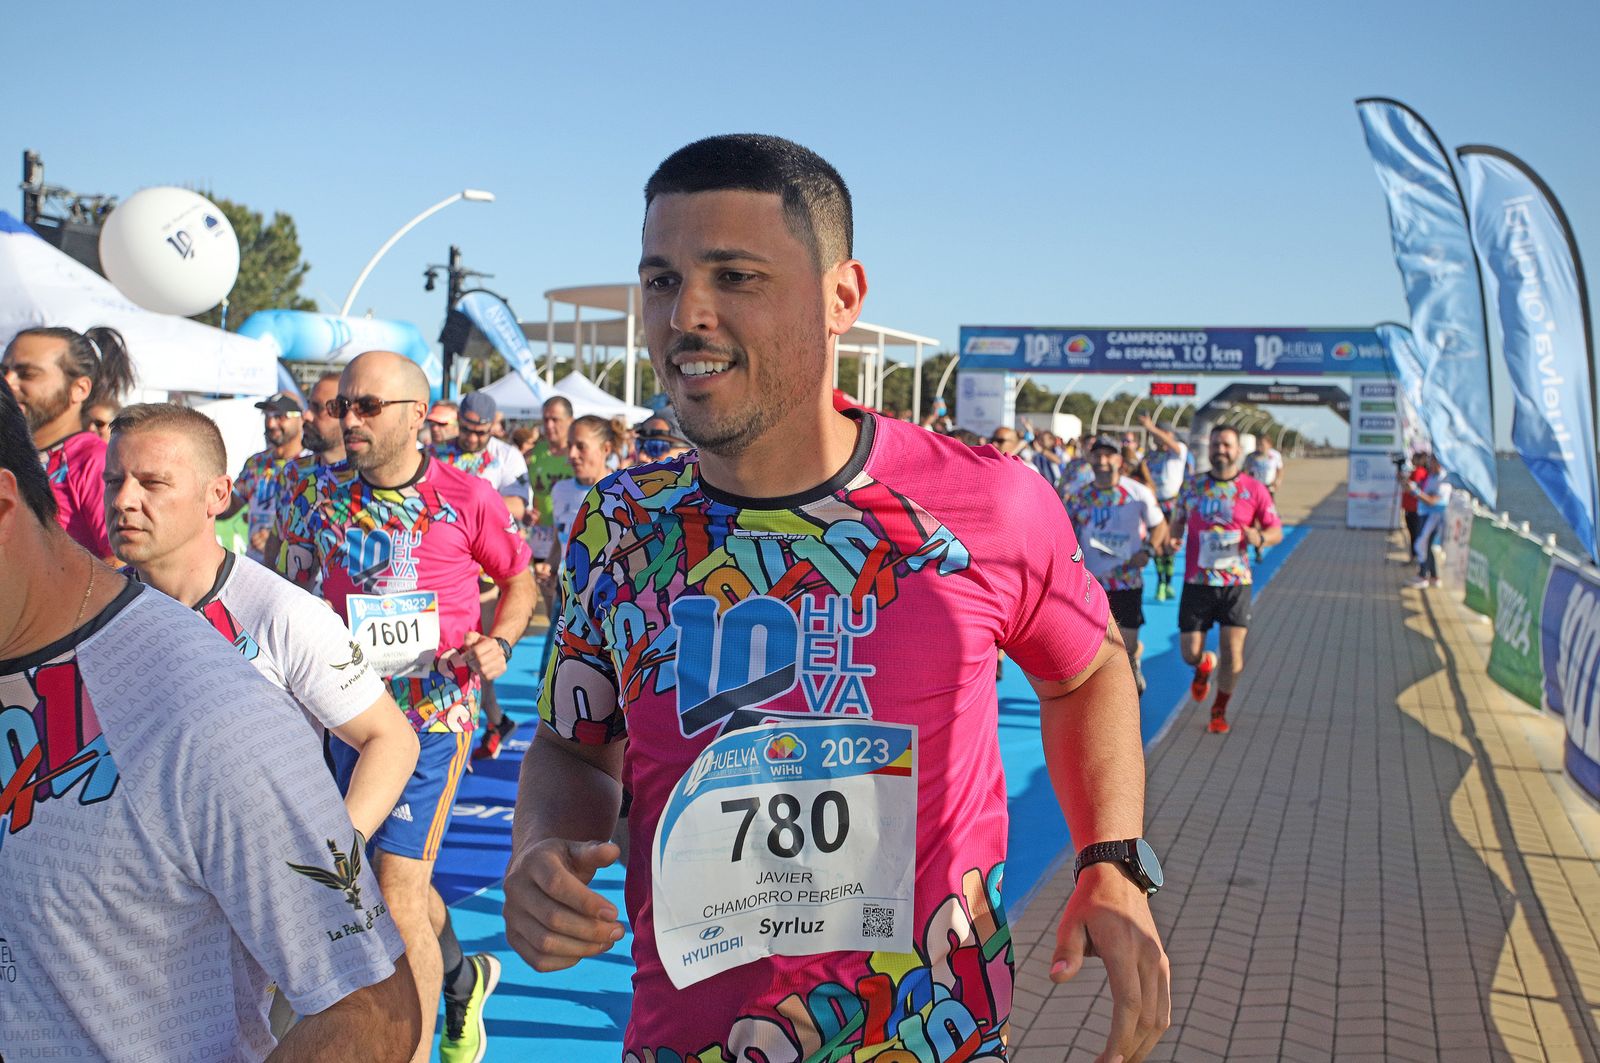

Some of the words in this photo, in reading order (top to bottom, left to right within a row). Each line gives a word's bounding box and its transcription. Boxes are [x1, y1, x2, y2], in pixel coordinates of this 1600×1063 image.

[1107, 332, 1207, 345] CAMPEONATO
[1106, 347, 1122, 360] de
[1124, 346, 1175, 360] ESPAÑA
[1183, 346, 1205, 360] 10
[1211, 345, 1243, 362] km
[392, 530, 422, 547] HU
[346, 528, 391, 584] 10
[392, 547, 418, 563] EL
[392, 562, 418, 578] VA
[400, 597, 427, 612] 2023
[803, 594, 876, 634] HU
[90, 609, 145, 652] LUCENA
[103, 614, 162, 661] PATERNA
[367, 618, 419, 647] 1601
[98, 627, 170, 686] CONDADO
[669, 595, 799, 738] 10
[802, 633, 876, 675] EL
[114, 675, 138, 698] DE
[137, 673, 169, 698] DEL
[800, 674, 873, 715] VA
[189, 700, 215, 723] DE
[202, 709, 240, 741] CALA
[125, 716, 167, 762] ZUFRE
[821, 737, 890, 768] 2023
[708, 745, 760, 773] HUELVA
[770, 764, 803, 777] WiHu
[720, 790, 850, 862] 780
[14, 848, 105, 876] VILLANUEVA
[756, 872, 813, 885] JAVIER
[15, 890, 97, 911] BERROCAL
[702, 890, 795, 920] CHAMORRO
[797, 882, 865, 903] PEREIRA
[117, 927, 140, 936] DE
[144, 907, 212, 935] ENMEDIO
[327, 929, 343, 942] La
[758, 917, 825, 936] Syrluz
[104, 944, 122, 957] EL
[125, 934, 178, 951] CERRO
[191, 952, 210, 967] LA
[682, 935, 744, 967] HYUNDAI
[107, 982, 169, 1014] MARINES
[173, 966, 231, 990] LUCENA
[28, 1009, 77, 1023] PALOS
[112, 995, 186, 1031] FRONTERA
[129, 1028, 155, 1045] DEL
[158, 1000, 234, 1033] CONDADO
[180, 1028, 205, 1045] DE
[199, 1042, 224, 1059] DEL
[20, 1046, 82, 1059] PUERTO
